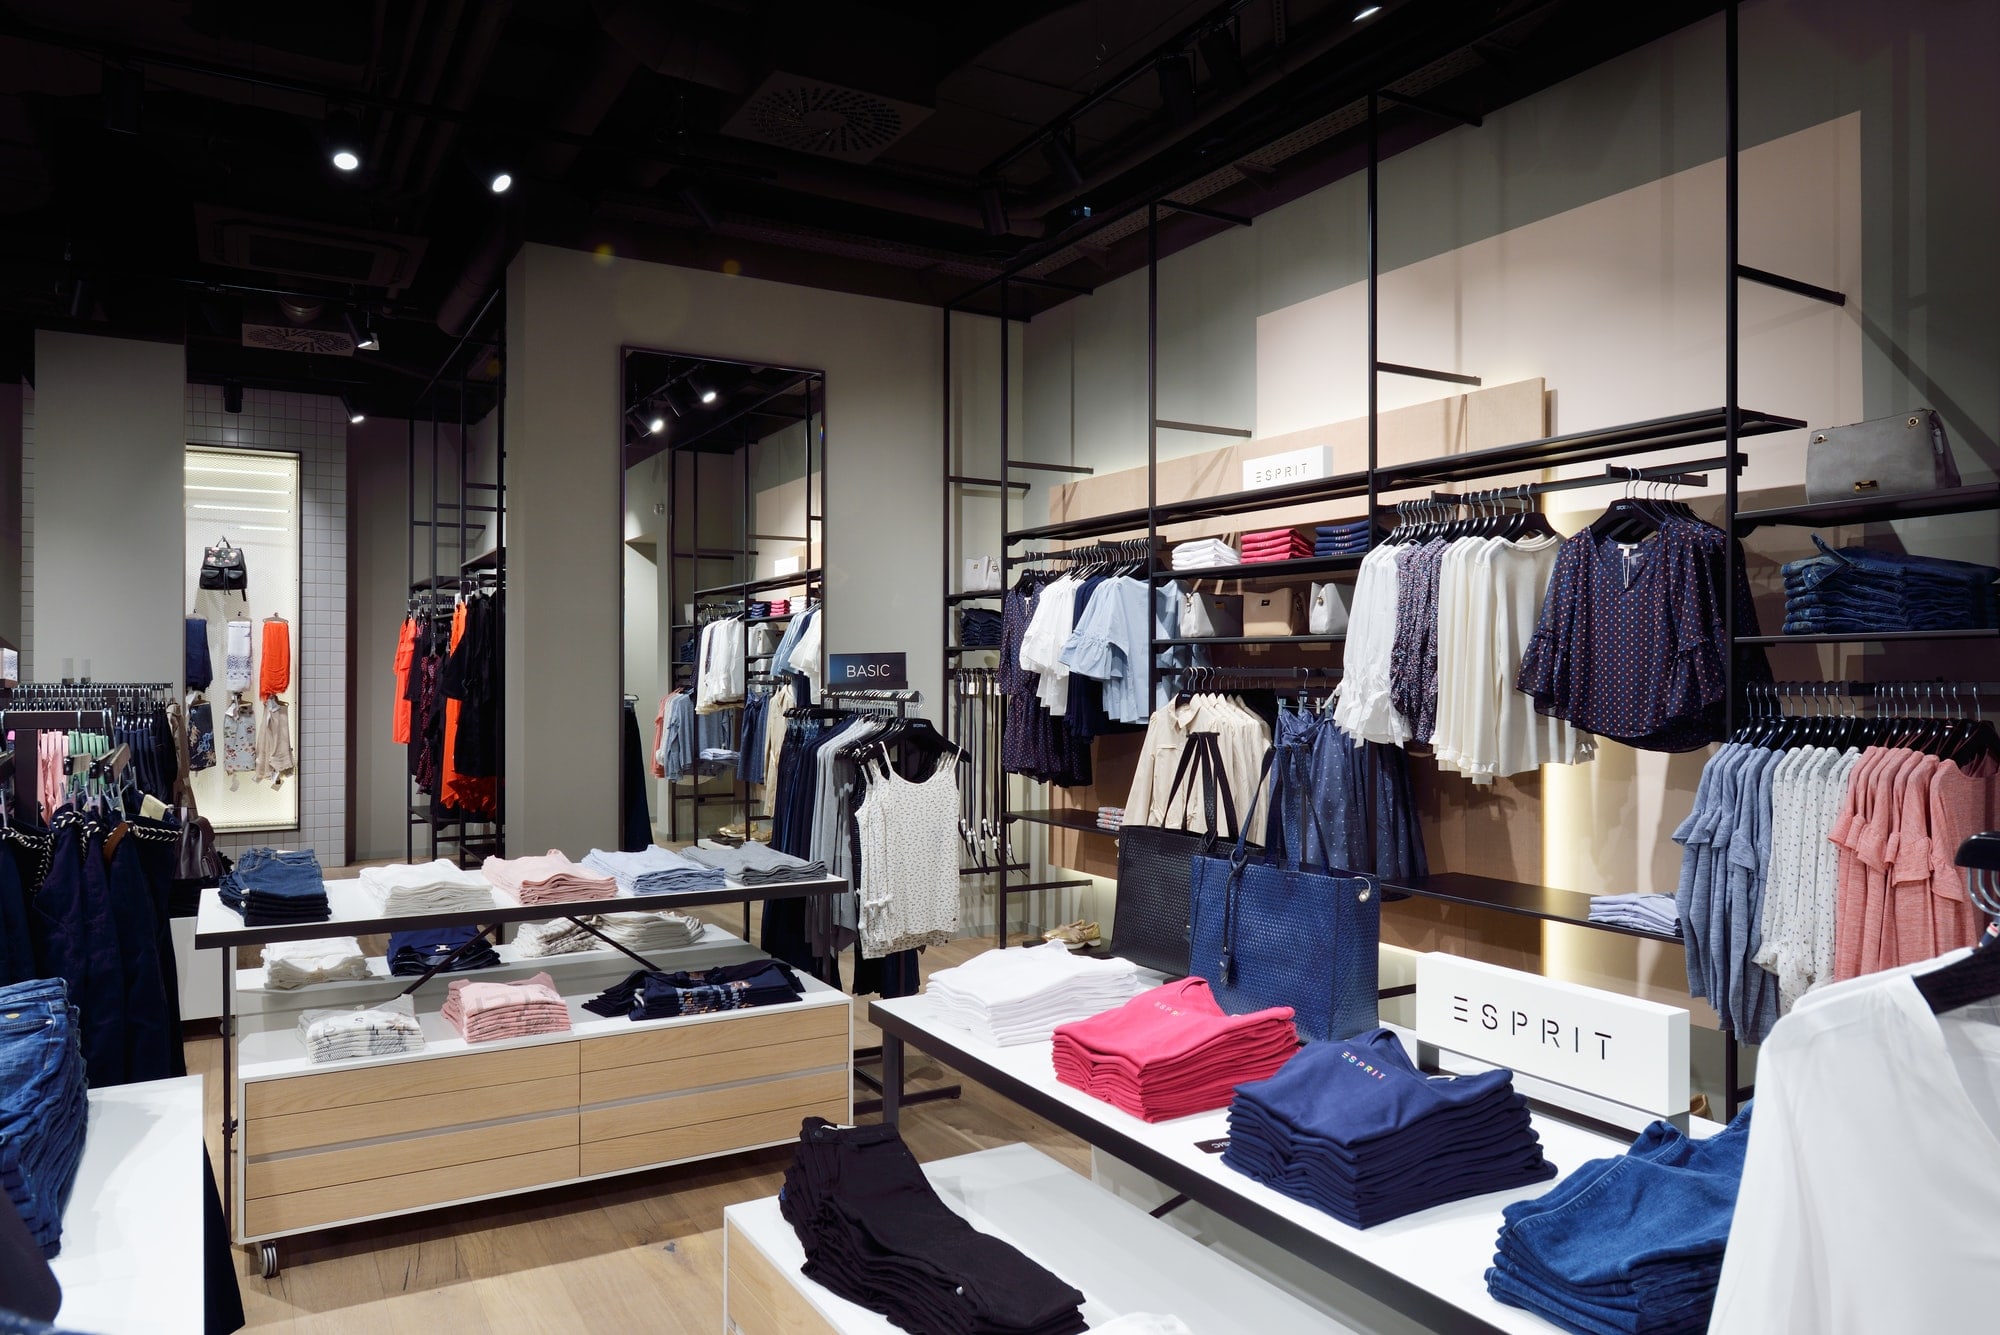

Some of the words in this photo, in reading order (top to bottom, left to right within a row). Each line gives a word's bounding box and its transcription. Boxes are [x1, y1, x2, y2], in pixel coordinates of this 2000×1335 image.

[1256, 463, 1307, 483] ESPRIT
[846, 664, 890, 678] BASIC
[1154, 1001, 1186, 1017] SPR
[1454, 996, 1612, 1060] ESPRIT
[1341, 1051, 1386, 1080] ESPRIT
